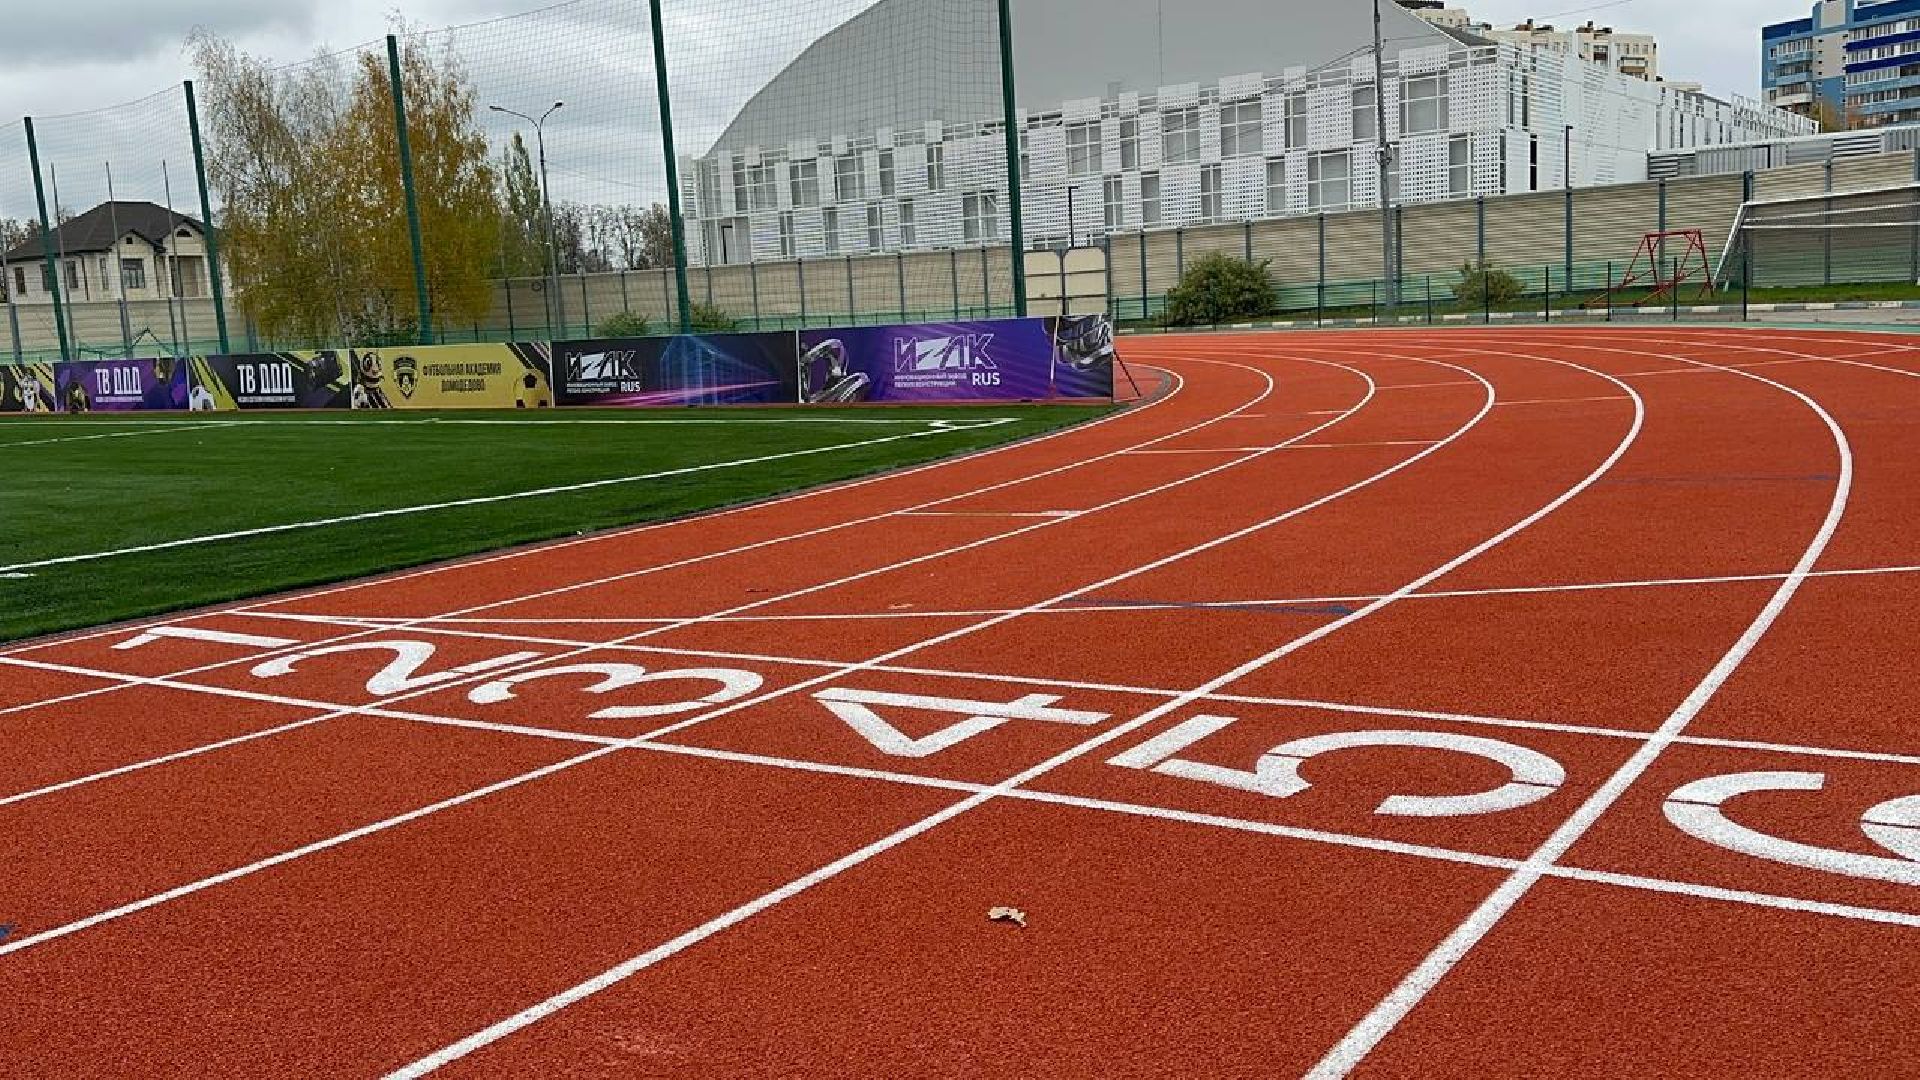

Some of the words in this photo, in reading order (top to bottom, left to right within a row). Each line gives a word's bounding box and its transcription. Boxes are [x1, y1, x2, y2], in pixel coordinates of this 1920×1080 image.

[620, 381, 641, 393] RUS
[972, 372, 1001, 386] RUS
[110, 626, 301, 650] 1
[250, 640, 545, 696] 2
[467, 662, 764, 720] 3
[811, 686, 1113, 758] 4
[1105, 713, 1568, 817] 5
